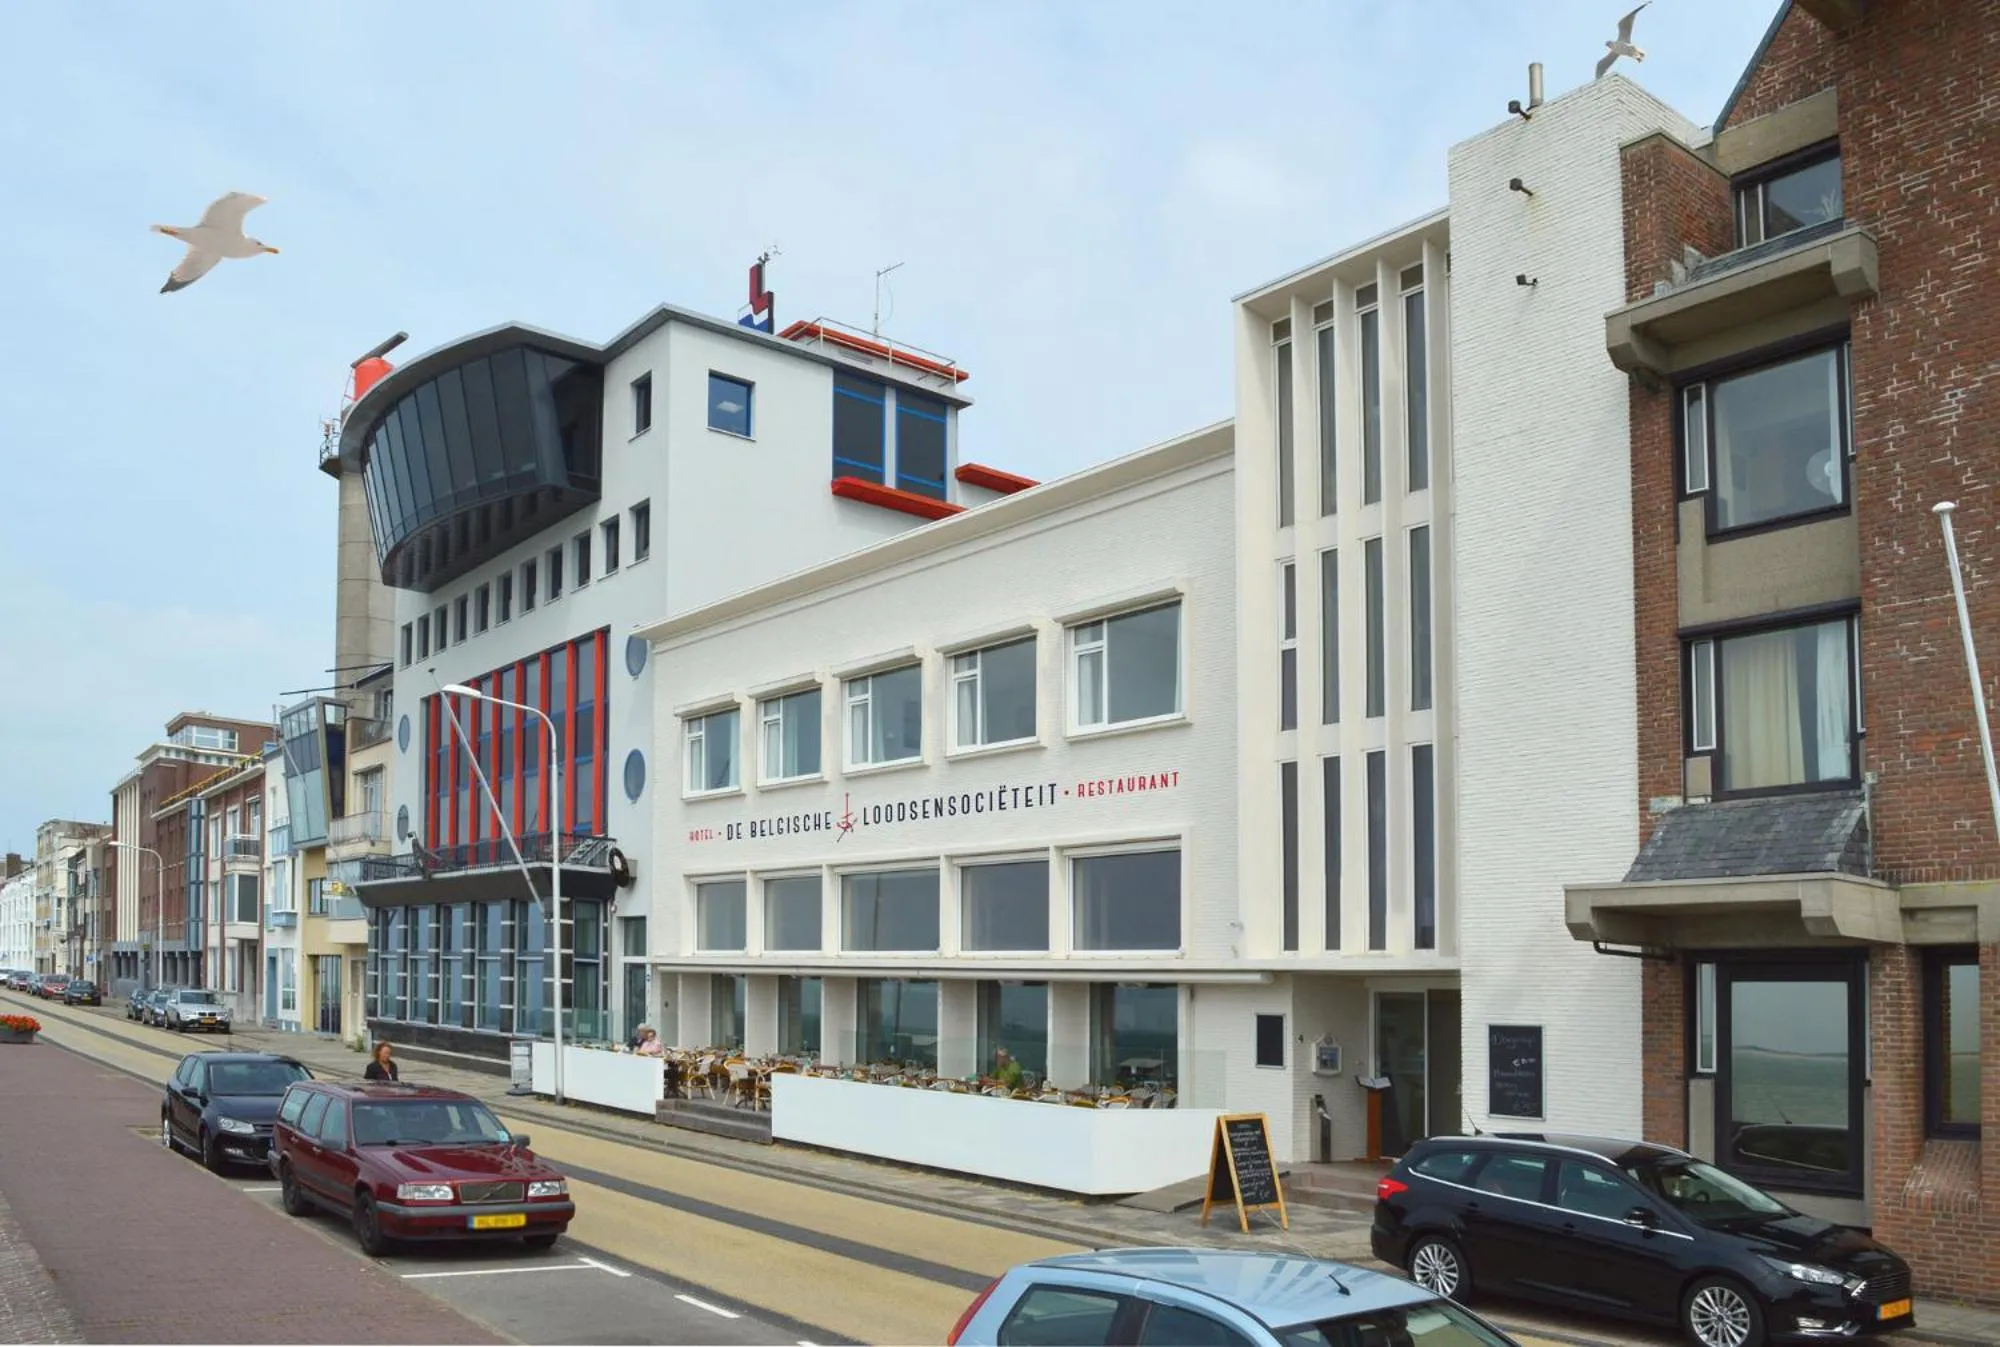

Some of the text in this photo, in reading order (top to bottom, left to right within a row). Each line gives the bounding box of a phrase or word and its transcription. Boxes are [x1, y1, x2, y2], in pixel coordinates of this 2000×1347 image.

[689, 772, 1179, 841] HOTEL DE BELGISCHE LOODSENSOCIËTEIT RESTAURANT
